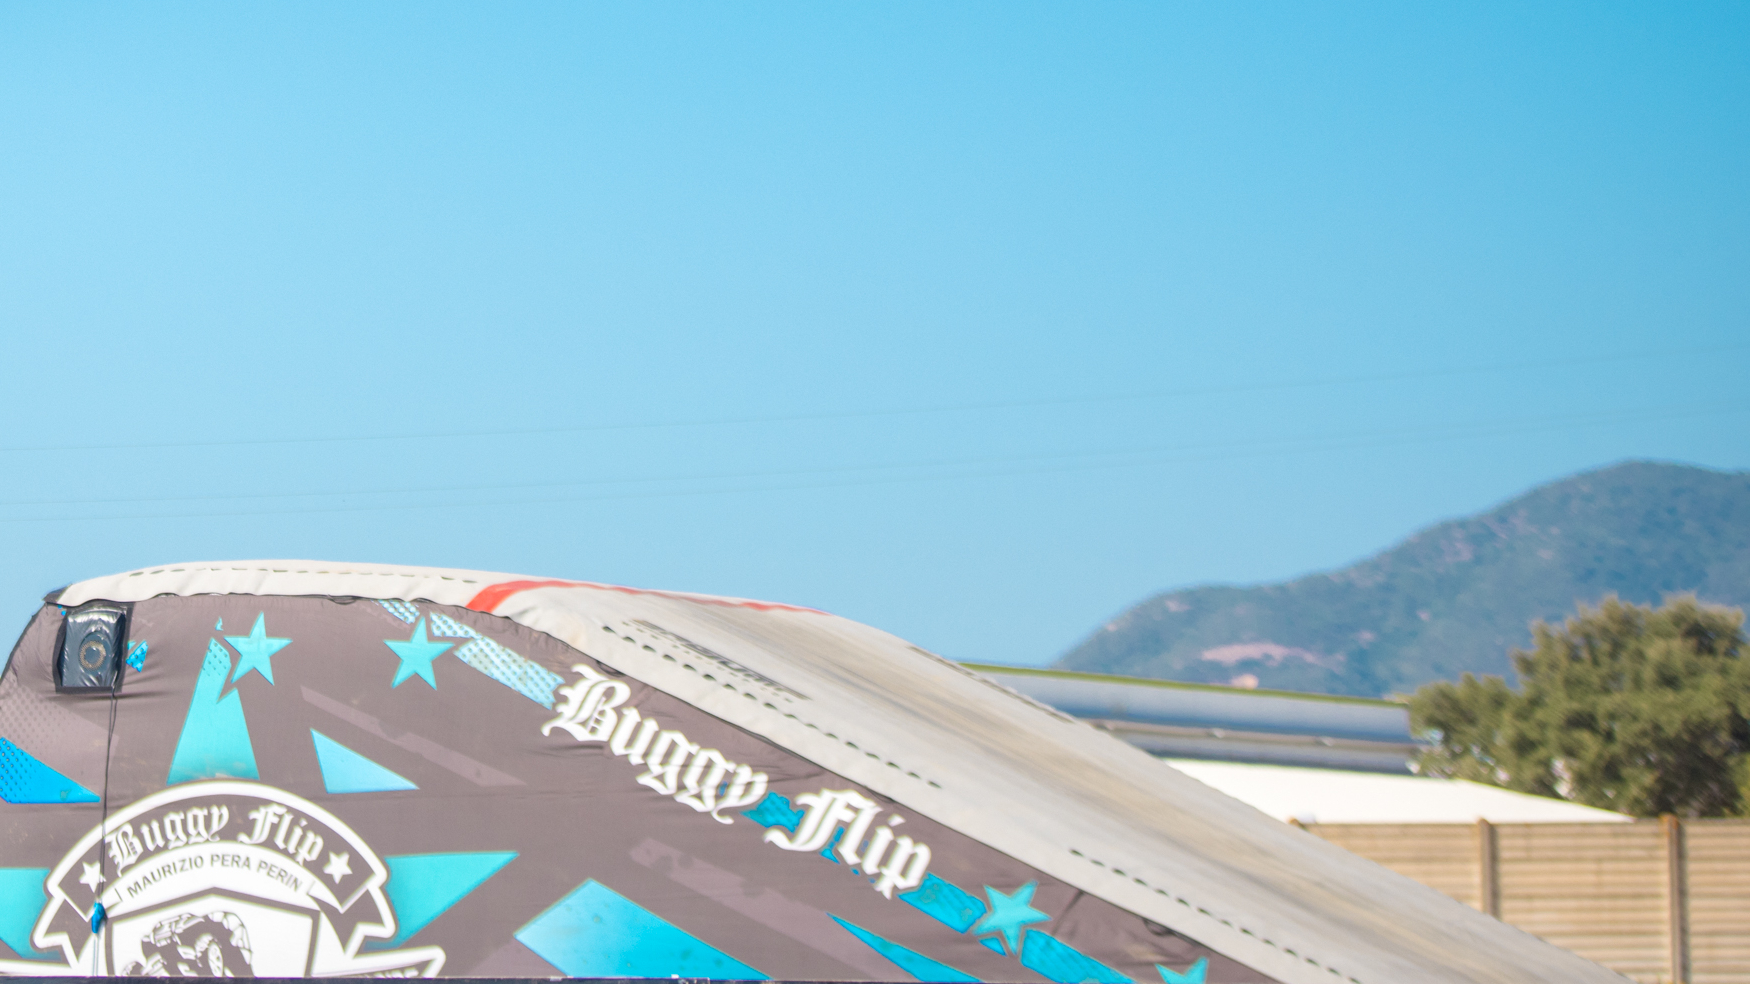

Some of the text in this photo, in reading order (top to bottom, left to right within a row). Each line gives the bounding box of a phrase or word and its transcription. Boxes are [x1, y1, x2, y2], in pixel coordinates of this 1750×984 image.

[541, 663, 932, 900] Buggy Flip
[106, 803, 324, 878] Buggy Flip
[127, 854, 303, 898] MAURIZIO PERA PERIN
